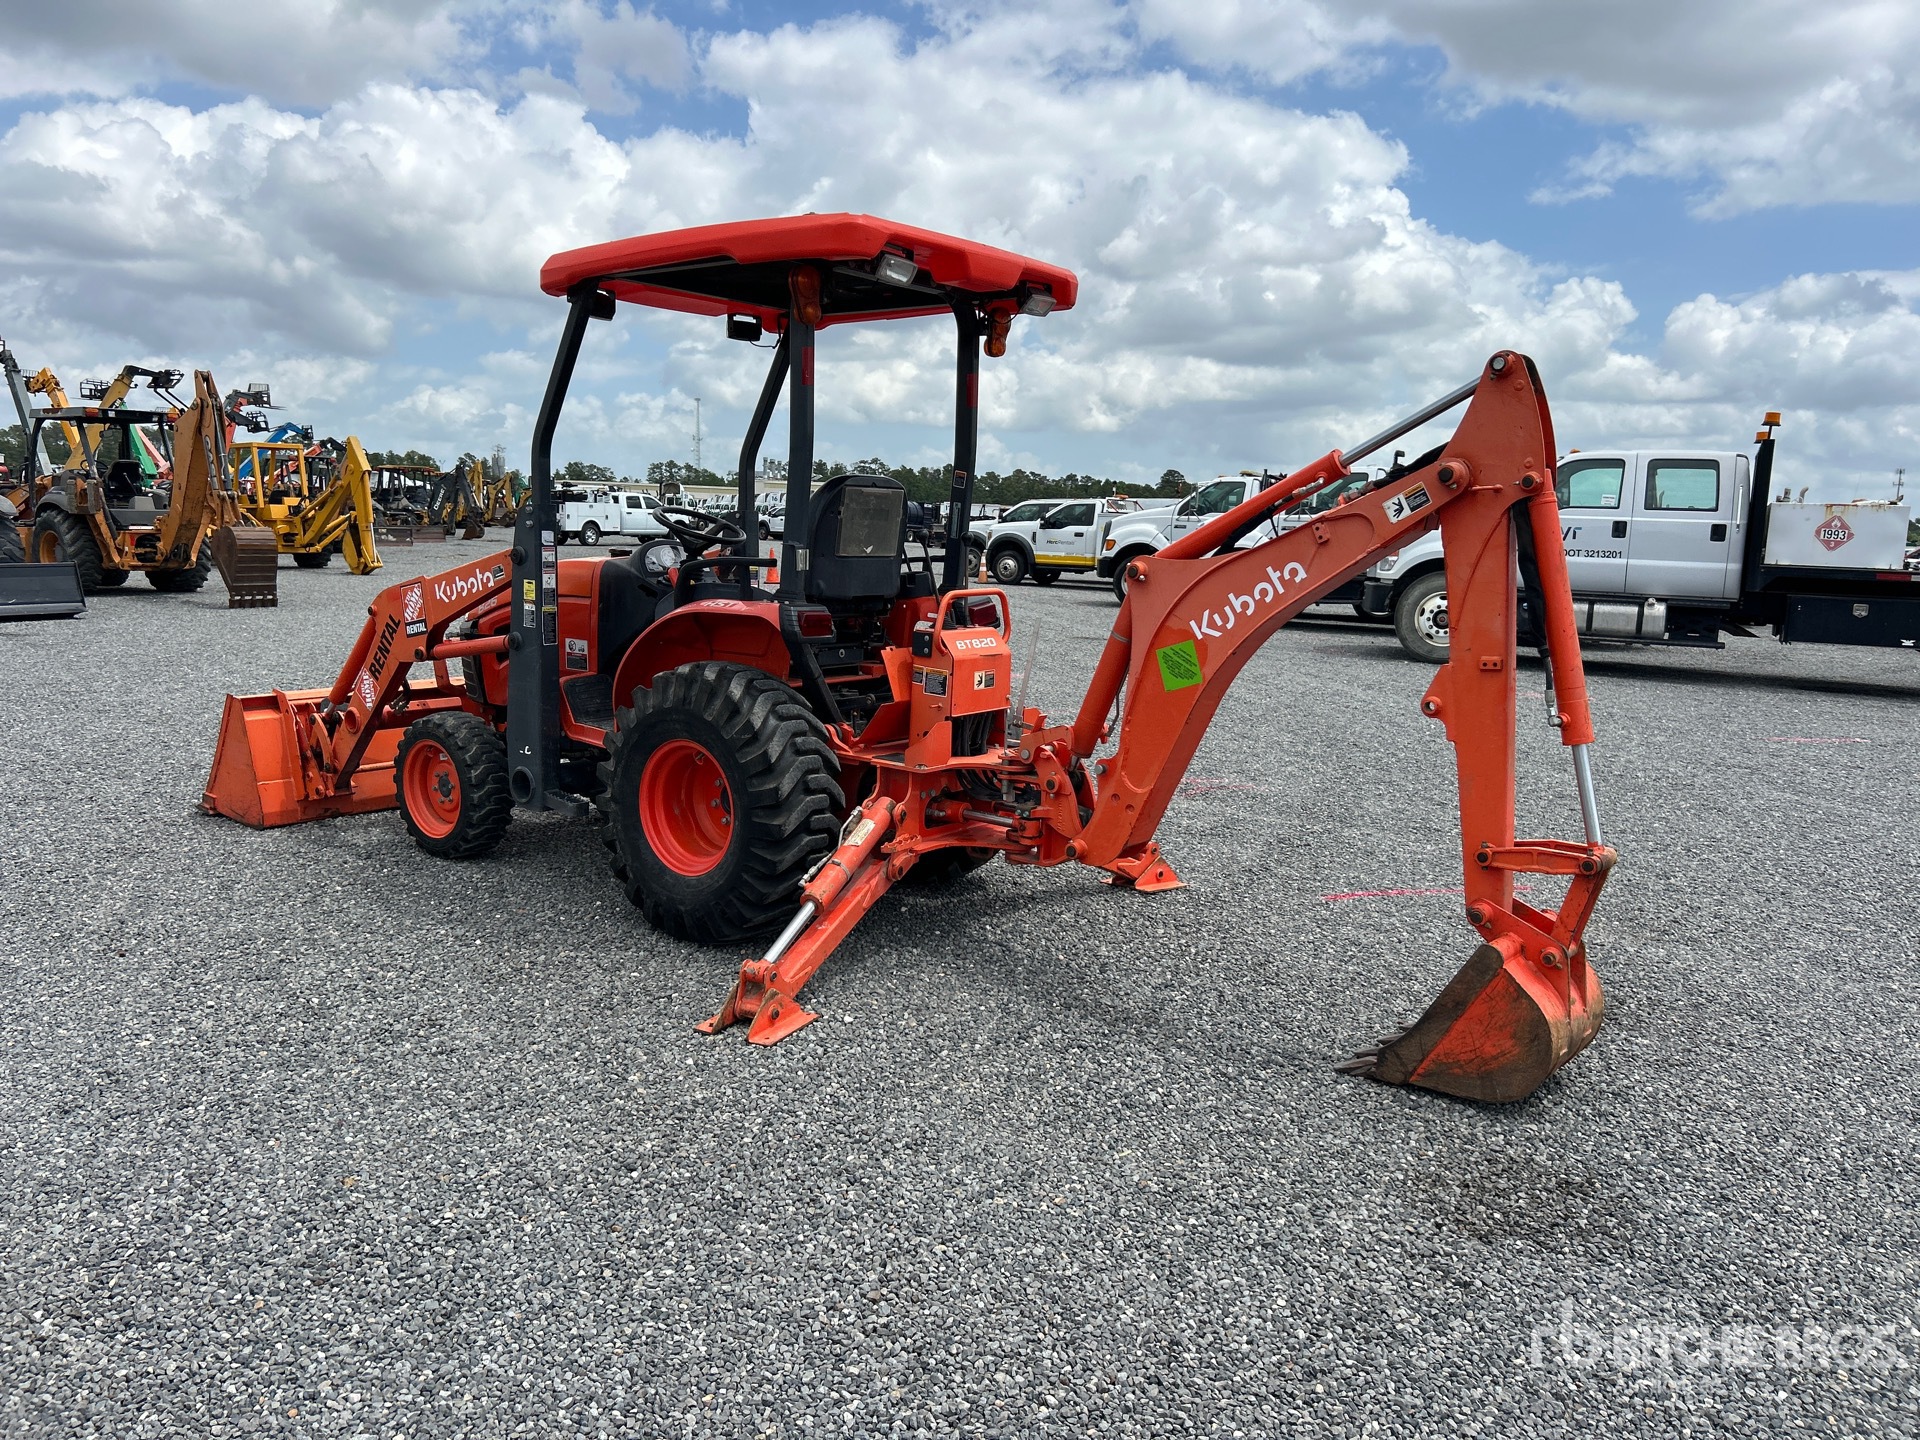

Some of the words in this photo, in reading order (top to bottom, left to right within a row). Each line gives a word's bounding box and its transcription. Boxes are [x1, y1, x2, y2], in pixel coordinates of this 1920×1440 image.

[1822, 529, 1847, 541] 1993
[1583, 549, 1623, 559] 3213201
[434, 568, 495, 603] Kubota
[1188, 561, 1308, 640] Kubota
[406, 622, 427, 635] RENTAL
[368, 613, 401, 682] RENTAL
[955, 637, 997, 650] BT820
